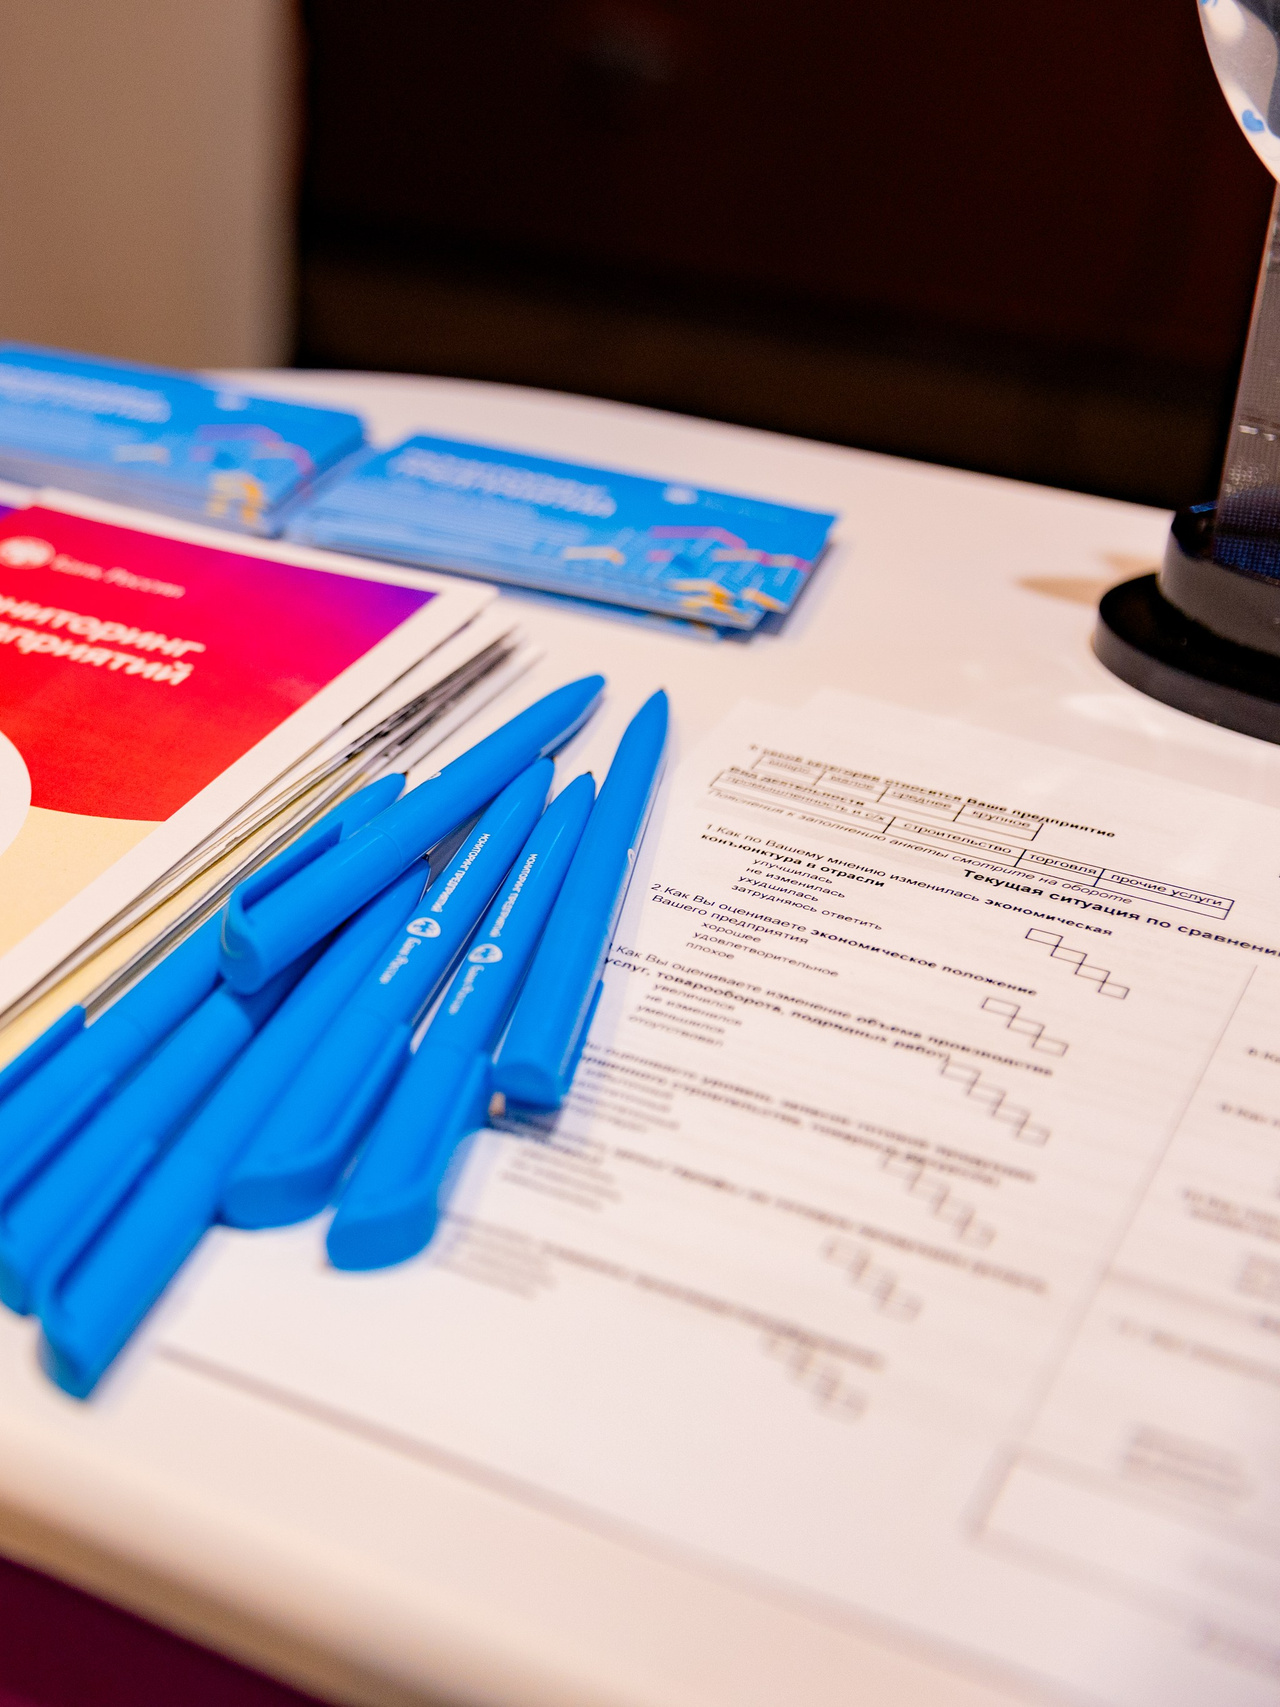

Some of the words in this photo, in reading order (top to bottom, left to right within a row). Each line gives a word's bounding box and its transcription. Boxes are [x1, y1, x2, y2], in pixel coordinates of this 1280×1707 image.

[966, 797, 1007, 812] Ваше
[1011, 808, 1116, 839] предприятие
[972, 809, 1031, 828] крупное
[700, 834, 803, 866] конъюнктура
[819, 864, 886, 888] отрасли
[745, 866, 763, 876] не
[765, 871, 846, 899] изменилась
[752, 857, 833, 885] улучшилась
[797, 814, 886, 841] заполнению
[889, 838, 949, 859] анкеты
[951, 855, 1035, 880] смотрите
[1039, 876, 1058, 886] на
[1061, 882, 1133, 905] обороте
[903, 821, 1012, 855] строительство
[1029, 853, 1098, 875] торговля
[1111, 872, 1167, 893] прочие
[1170, 888, 1223, 908] услуги
[731, 883, 818, 914] затрудняюсь
[821, 908, 882, 931] ответить
[738, 874, 820, 902] ухудшилась
[744, 834, 762, 844] по
[765, 838, 824, 861] Вашему
[827, 856, 886, 878] мнению
[889, 872, 981, 903] изменилась
[983, 898, 1113, 937] экономическая
[651, 893, 708, 917] Вашего
[710, 911, 810, 945] предприятия
[701, 921, 762, 944] хорошее
[963, 868, 1045, 898] Текущая
[1049, 890, 1141, 922] ситуация
[1145, 916, 1173, 930] по
[1177, 923, 1280, 957] сравнени
[685, 940, 735, 961] плохое
[692, 930, 839, 978] удовлетворительное
[693, 893, 716, 908] Вы
[718, 902, 807, 933] оцениваете
[810, 927, 938, 969] экономическое
[941, 964, 1038, 997] положение
[645, 952, 669, 967] Вы
[671, 962, 763, 994] оцениваете
[765, 989, 852, 1019] изменение
